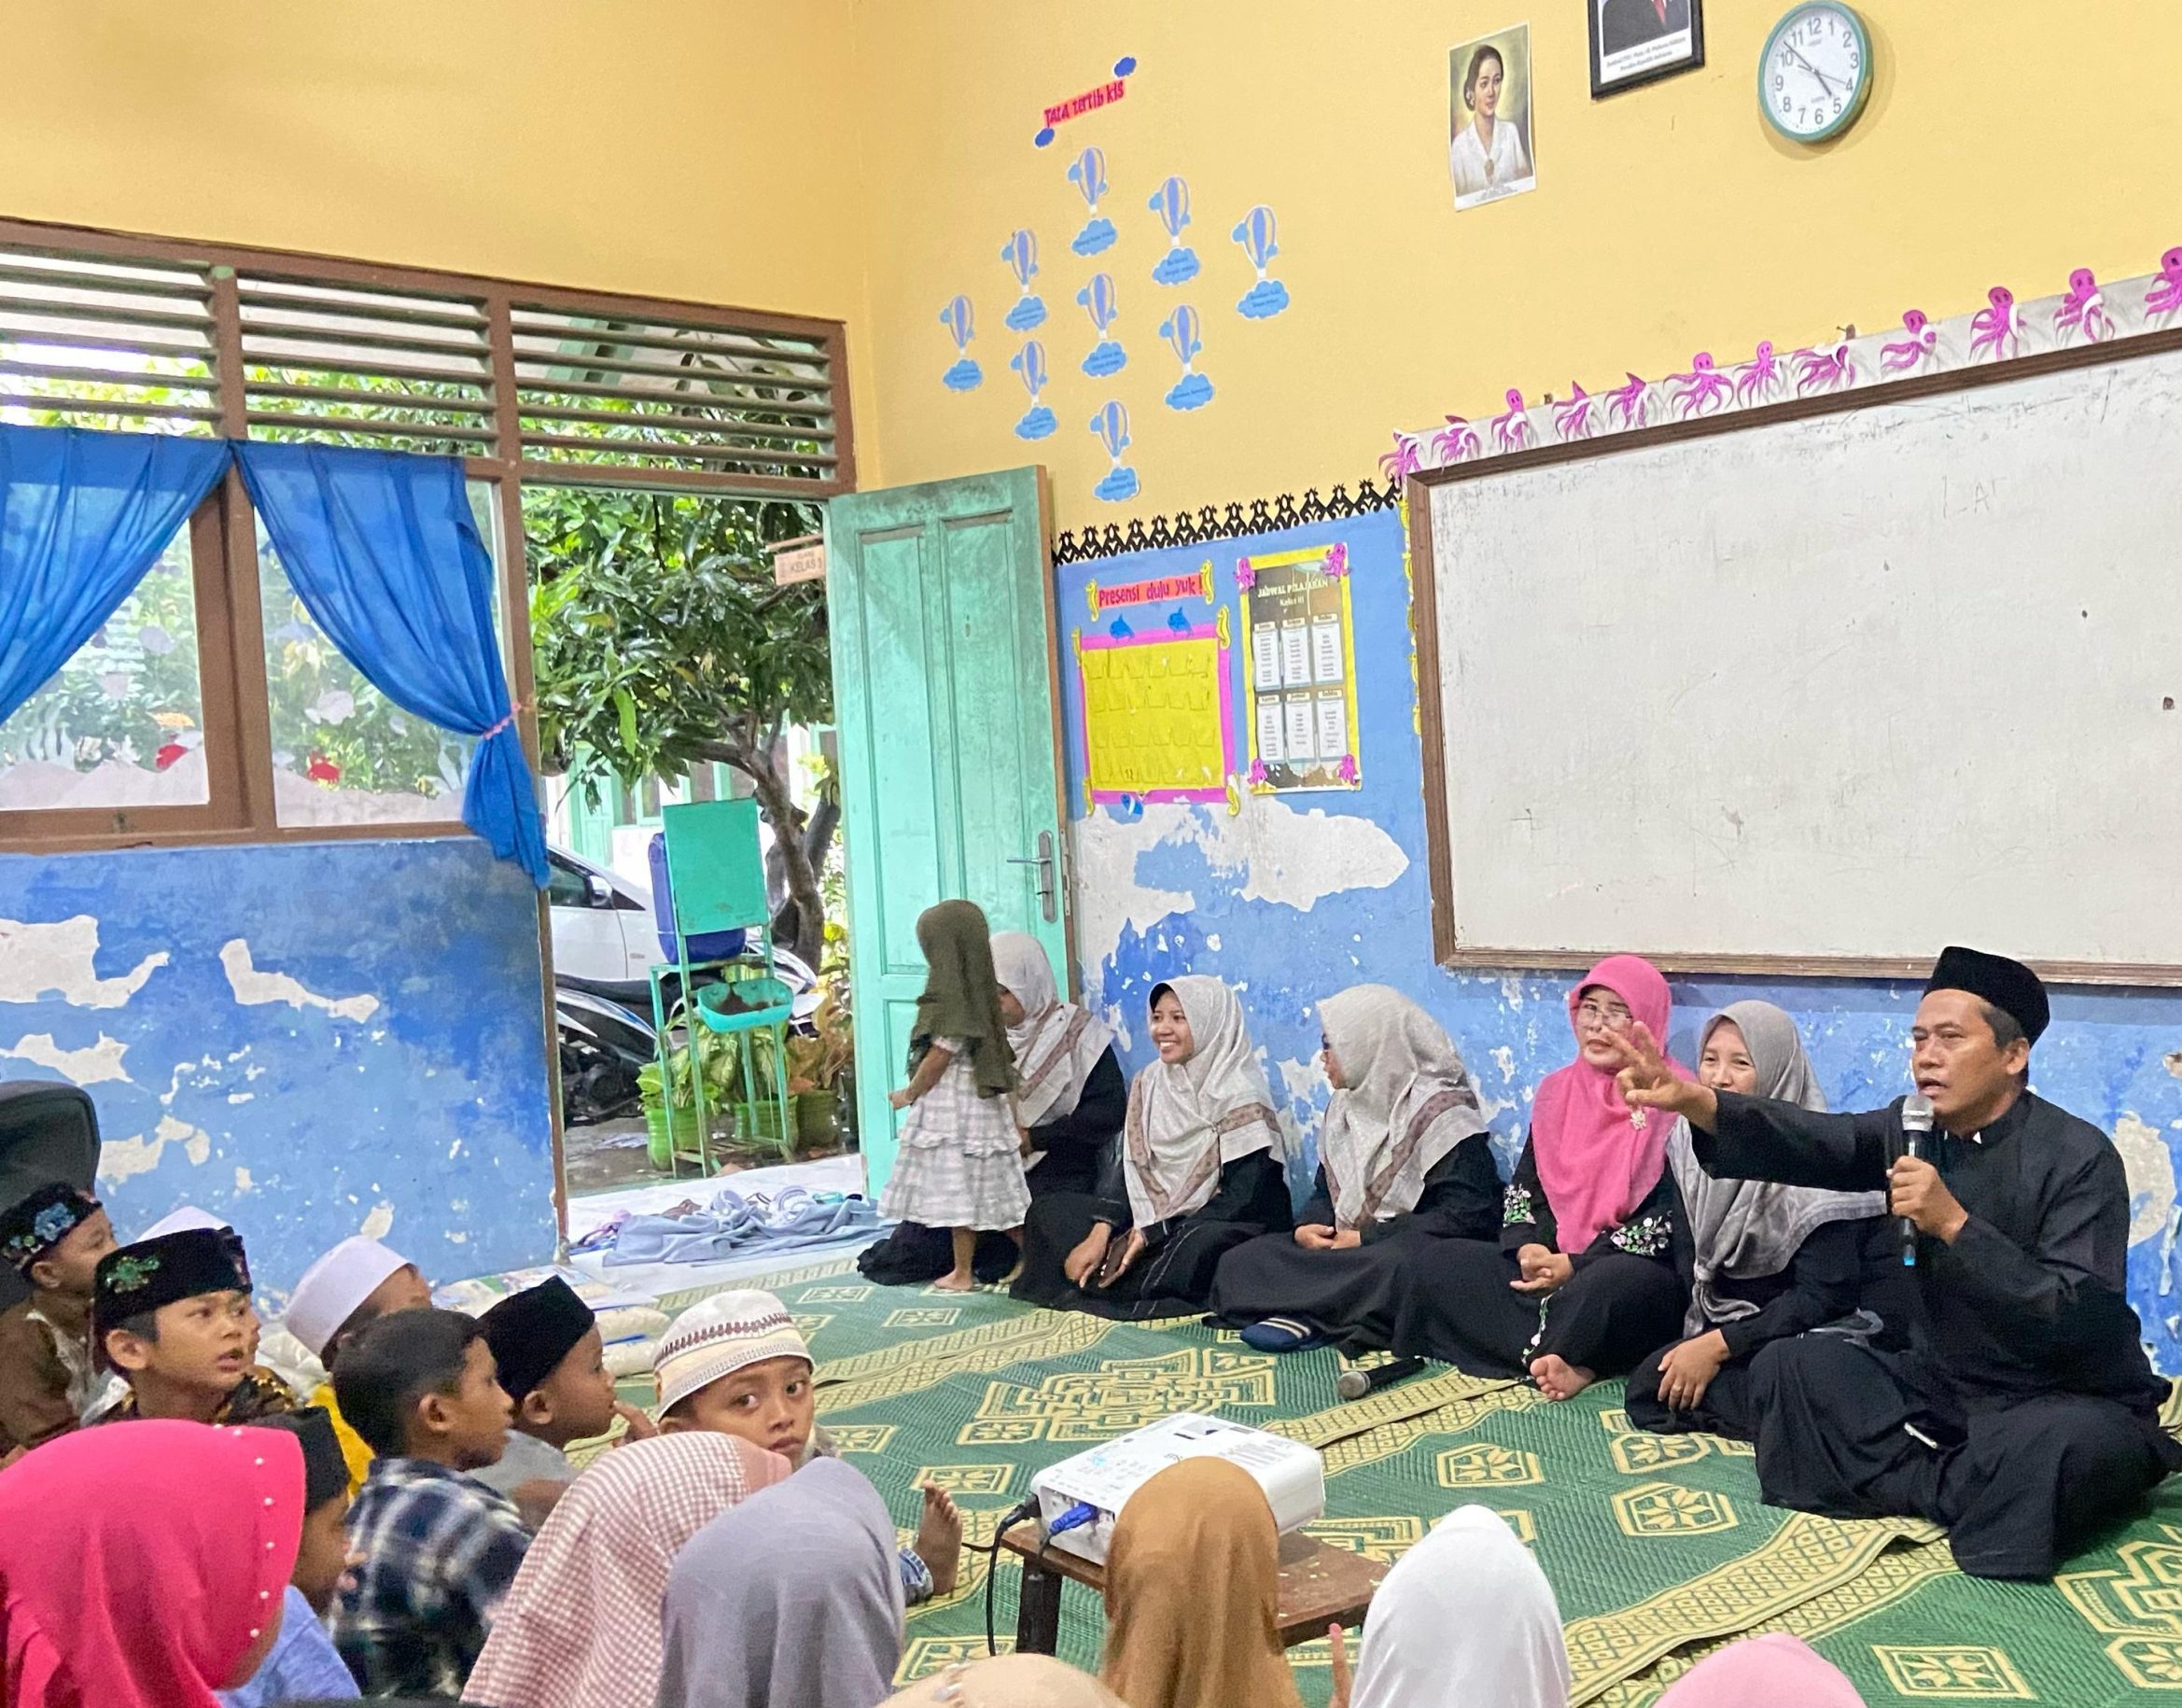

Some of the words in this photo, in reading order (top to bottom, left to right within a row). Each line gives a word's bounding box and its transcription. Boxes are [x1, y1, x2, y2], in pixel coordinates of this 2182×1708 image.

[1807, 18, 1822, 36] 12
[1828, 19, 1834, 35] 1
[1792, 30, 1804, 47] 11
[1842, 31, 1852, 49] 2
[1781, 50, 1794, 67] 10
[1850, 52, 1859, 69] 3
[1775, 75, 1784, 91] 9
[1845, 77, 1853, 91] 4
[1783, 96, 1792, 113] 8
[1833, 97, 1842, 114] 5
[1797, 107, 1807, 124] 7
[1814, 108, 1824, 125] 6
[790, 558, 817, 573] KELAS
[1098, 584, 1140, 608] Presensi
[1146, 581, 1169, 600] dulu
[1258, 584, 1286, 598] JADWAL
[1287, 578, 1328, 594] PELAJARAN
